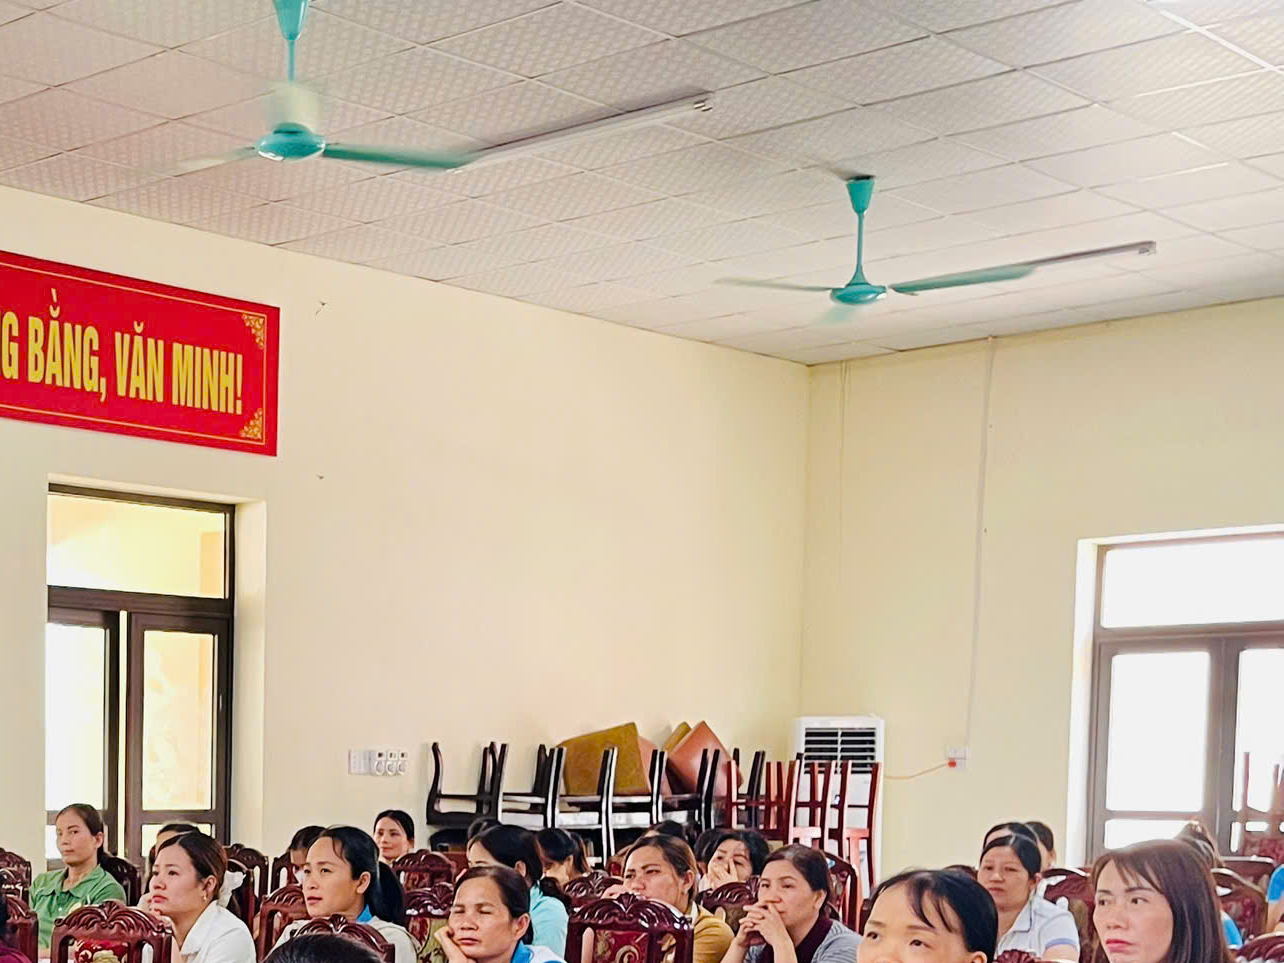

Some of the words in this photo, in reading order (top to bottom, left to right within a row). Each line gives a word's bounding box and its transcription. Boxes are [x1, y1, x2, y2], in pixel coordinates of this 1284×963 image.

[28, 289, 107, 402] BẰNG,
[115, 323, 165, 406] VĂN
[172, 343, 243, 414] MINH!
